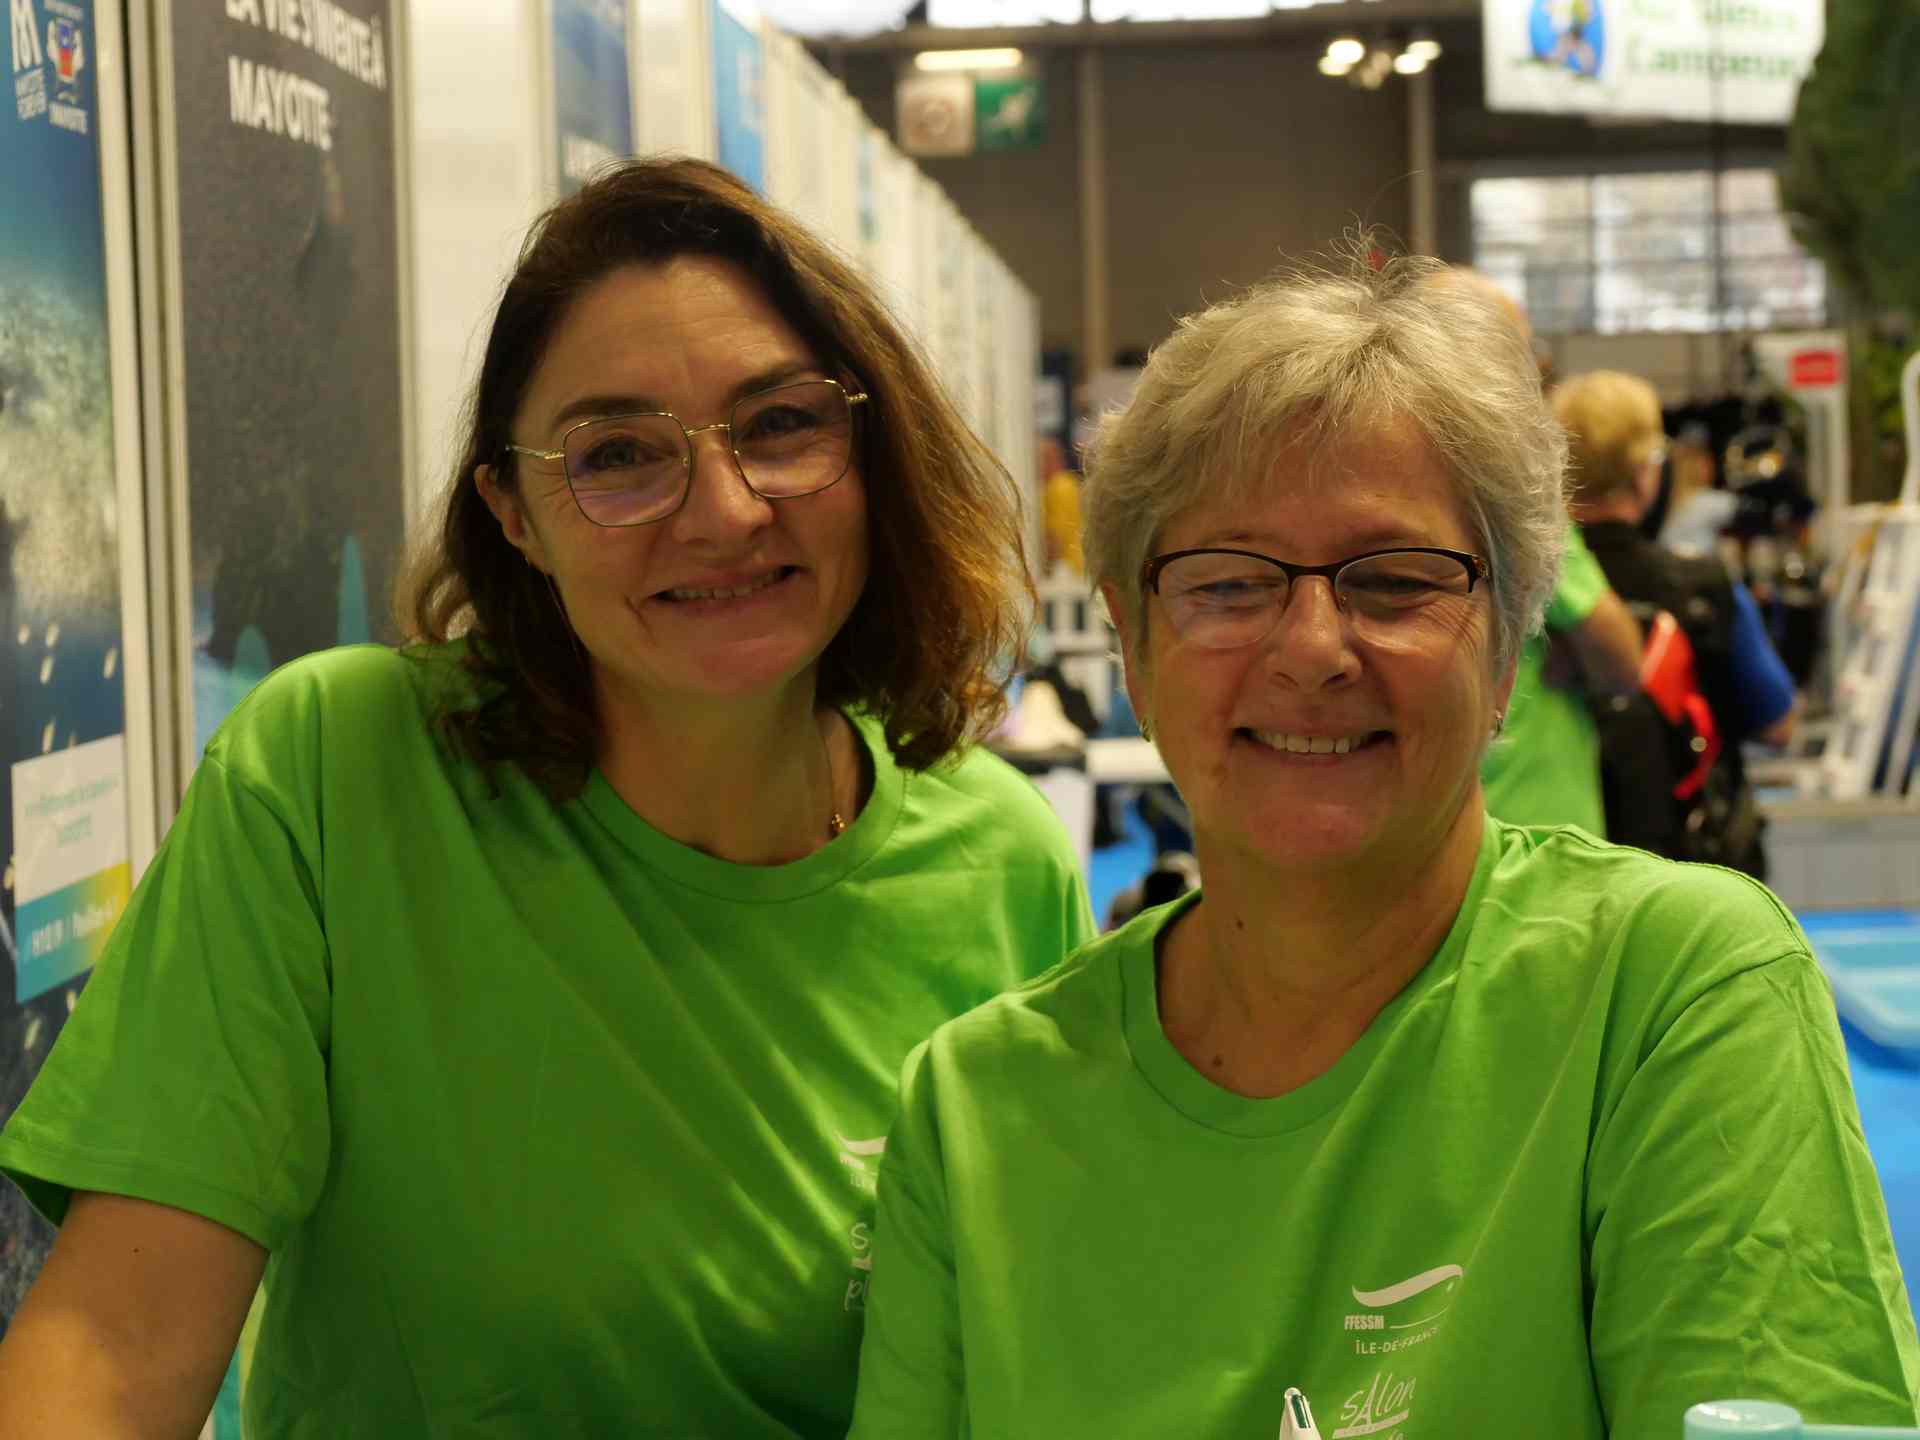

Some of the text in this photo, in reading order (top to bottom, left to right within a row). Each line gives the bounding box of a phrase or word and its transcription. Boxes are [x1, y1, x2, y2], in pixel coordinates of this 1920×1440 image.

[228, 55, 332, 151] MAYOTTE
[1344, 1315, 1385, 1330] FFESSM
[1355, 1327, 1440, 1354] ÎLE-DE-FRANC
